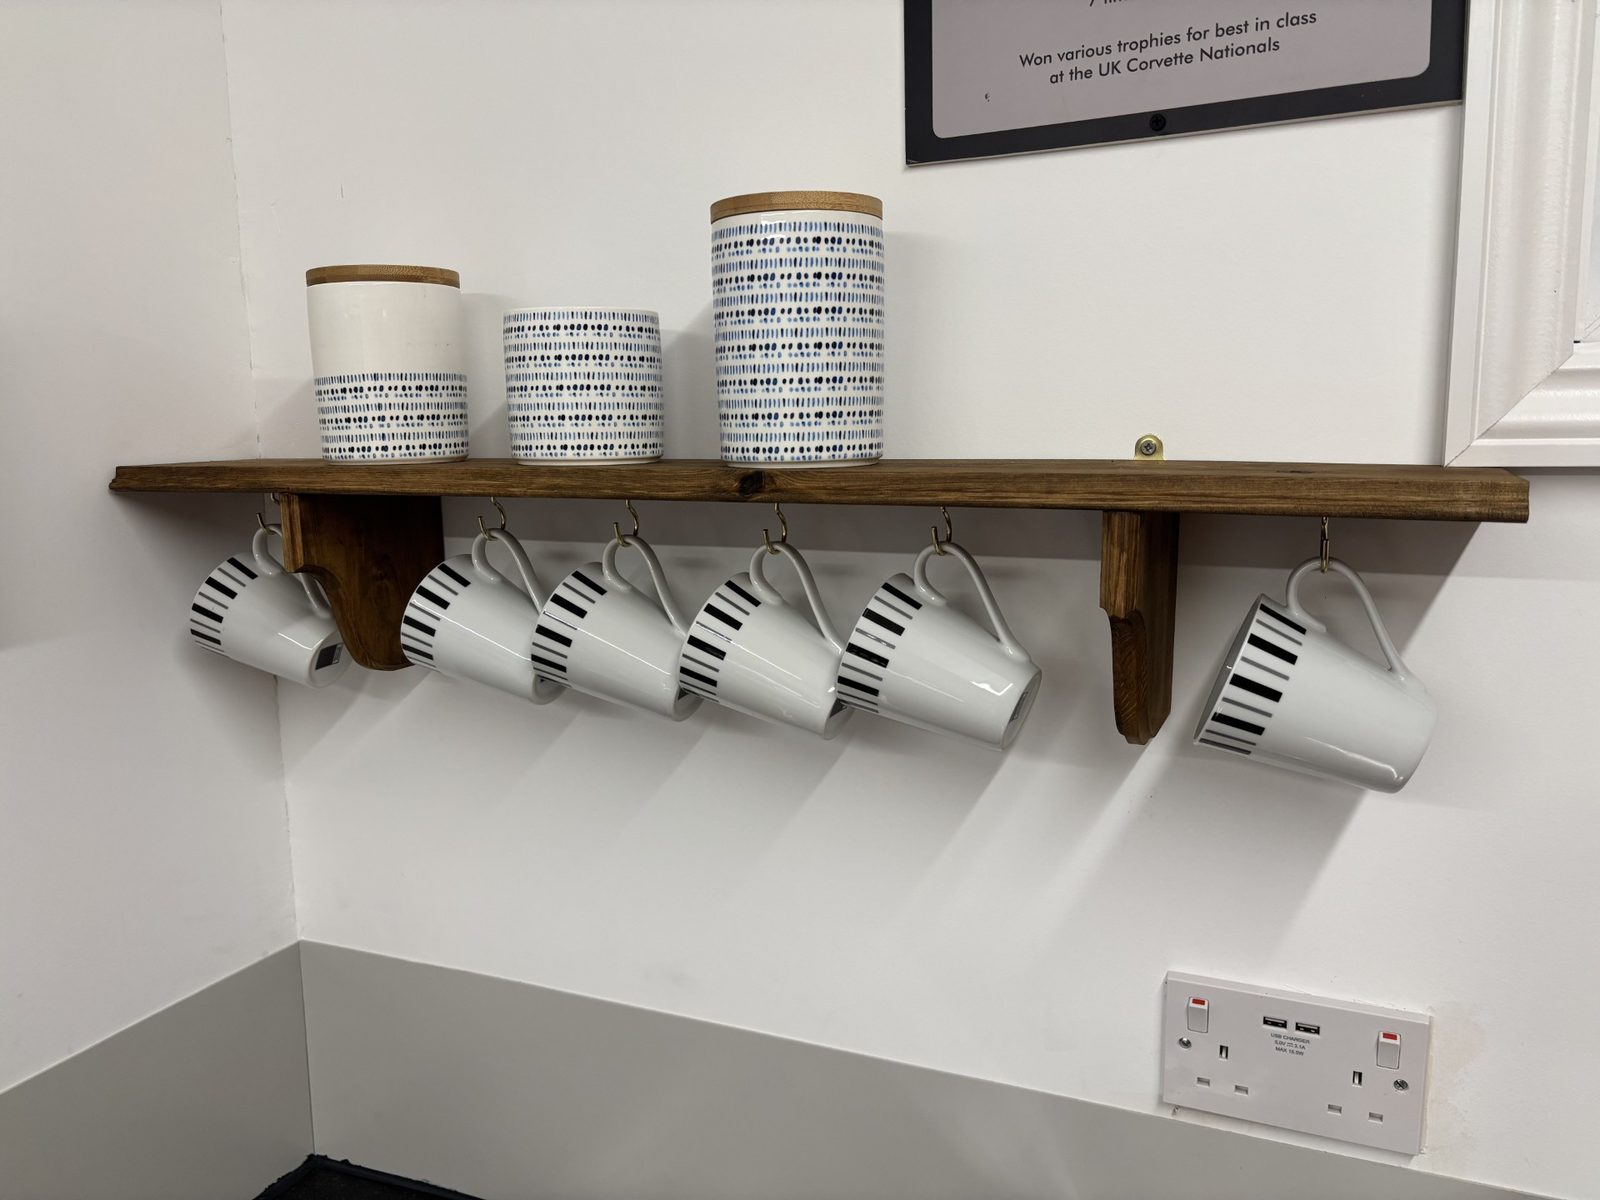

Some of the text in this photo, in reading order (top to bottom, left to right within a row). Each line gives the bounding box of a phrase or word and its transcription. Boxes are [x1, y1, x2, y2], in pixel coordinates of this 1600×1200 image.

[1019, 12, 1317, 67] Won various trophies for best in class
[1049, 36, 1280, 84] at the UK Corvette Nationals
[1283, 1035, 1309, 1044] CHARGER
